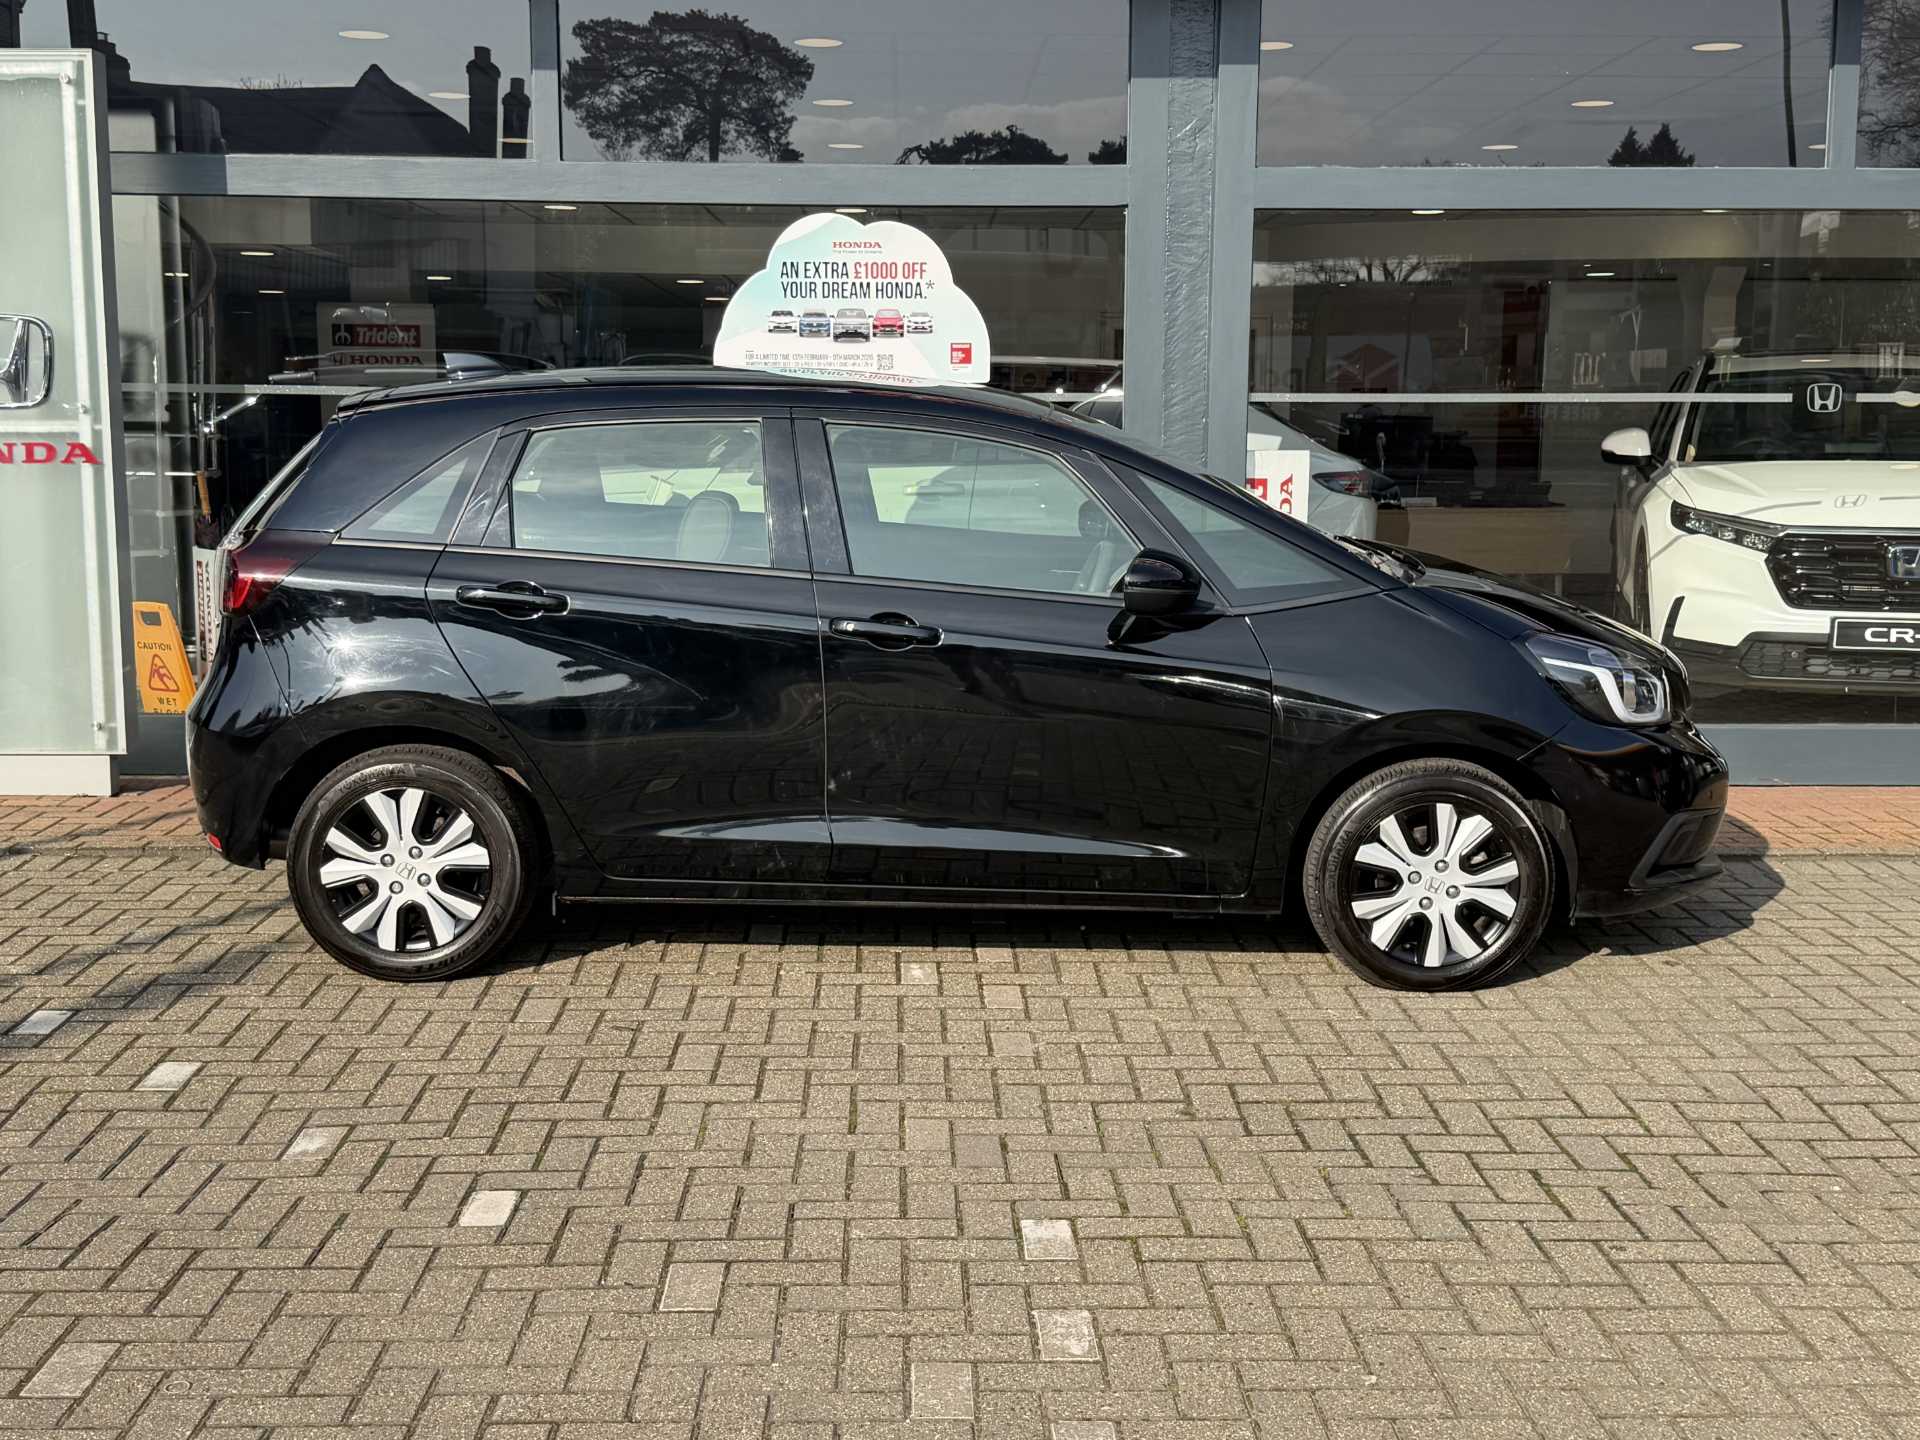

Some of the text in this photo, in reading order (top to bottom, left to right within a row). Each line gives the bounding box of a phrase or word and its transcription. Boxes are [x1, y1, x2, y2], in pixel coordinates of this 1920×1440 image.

[832, 241, 882, 249] HONDA
[780, 261, 928, 280] AN EXTRA £1000 OFF
[780, 281, 818, 299] YOUR
[822, 281, 871, 299] DREAM
[356, 326, 417, 346] Trident
[350, 355, 422, 366] HONDA
[136, 640, 172, 652] CAUTION
[156, 696, 177, 706] WET
